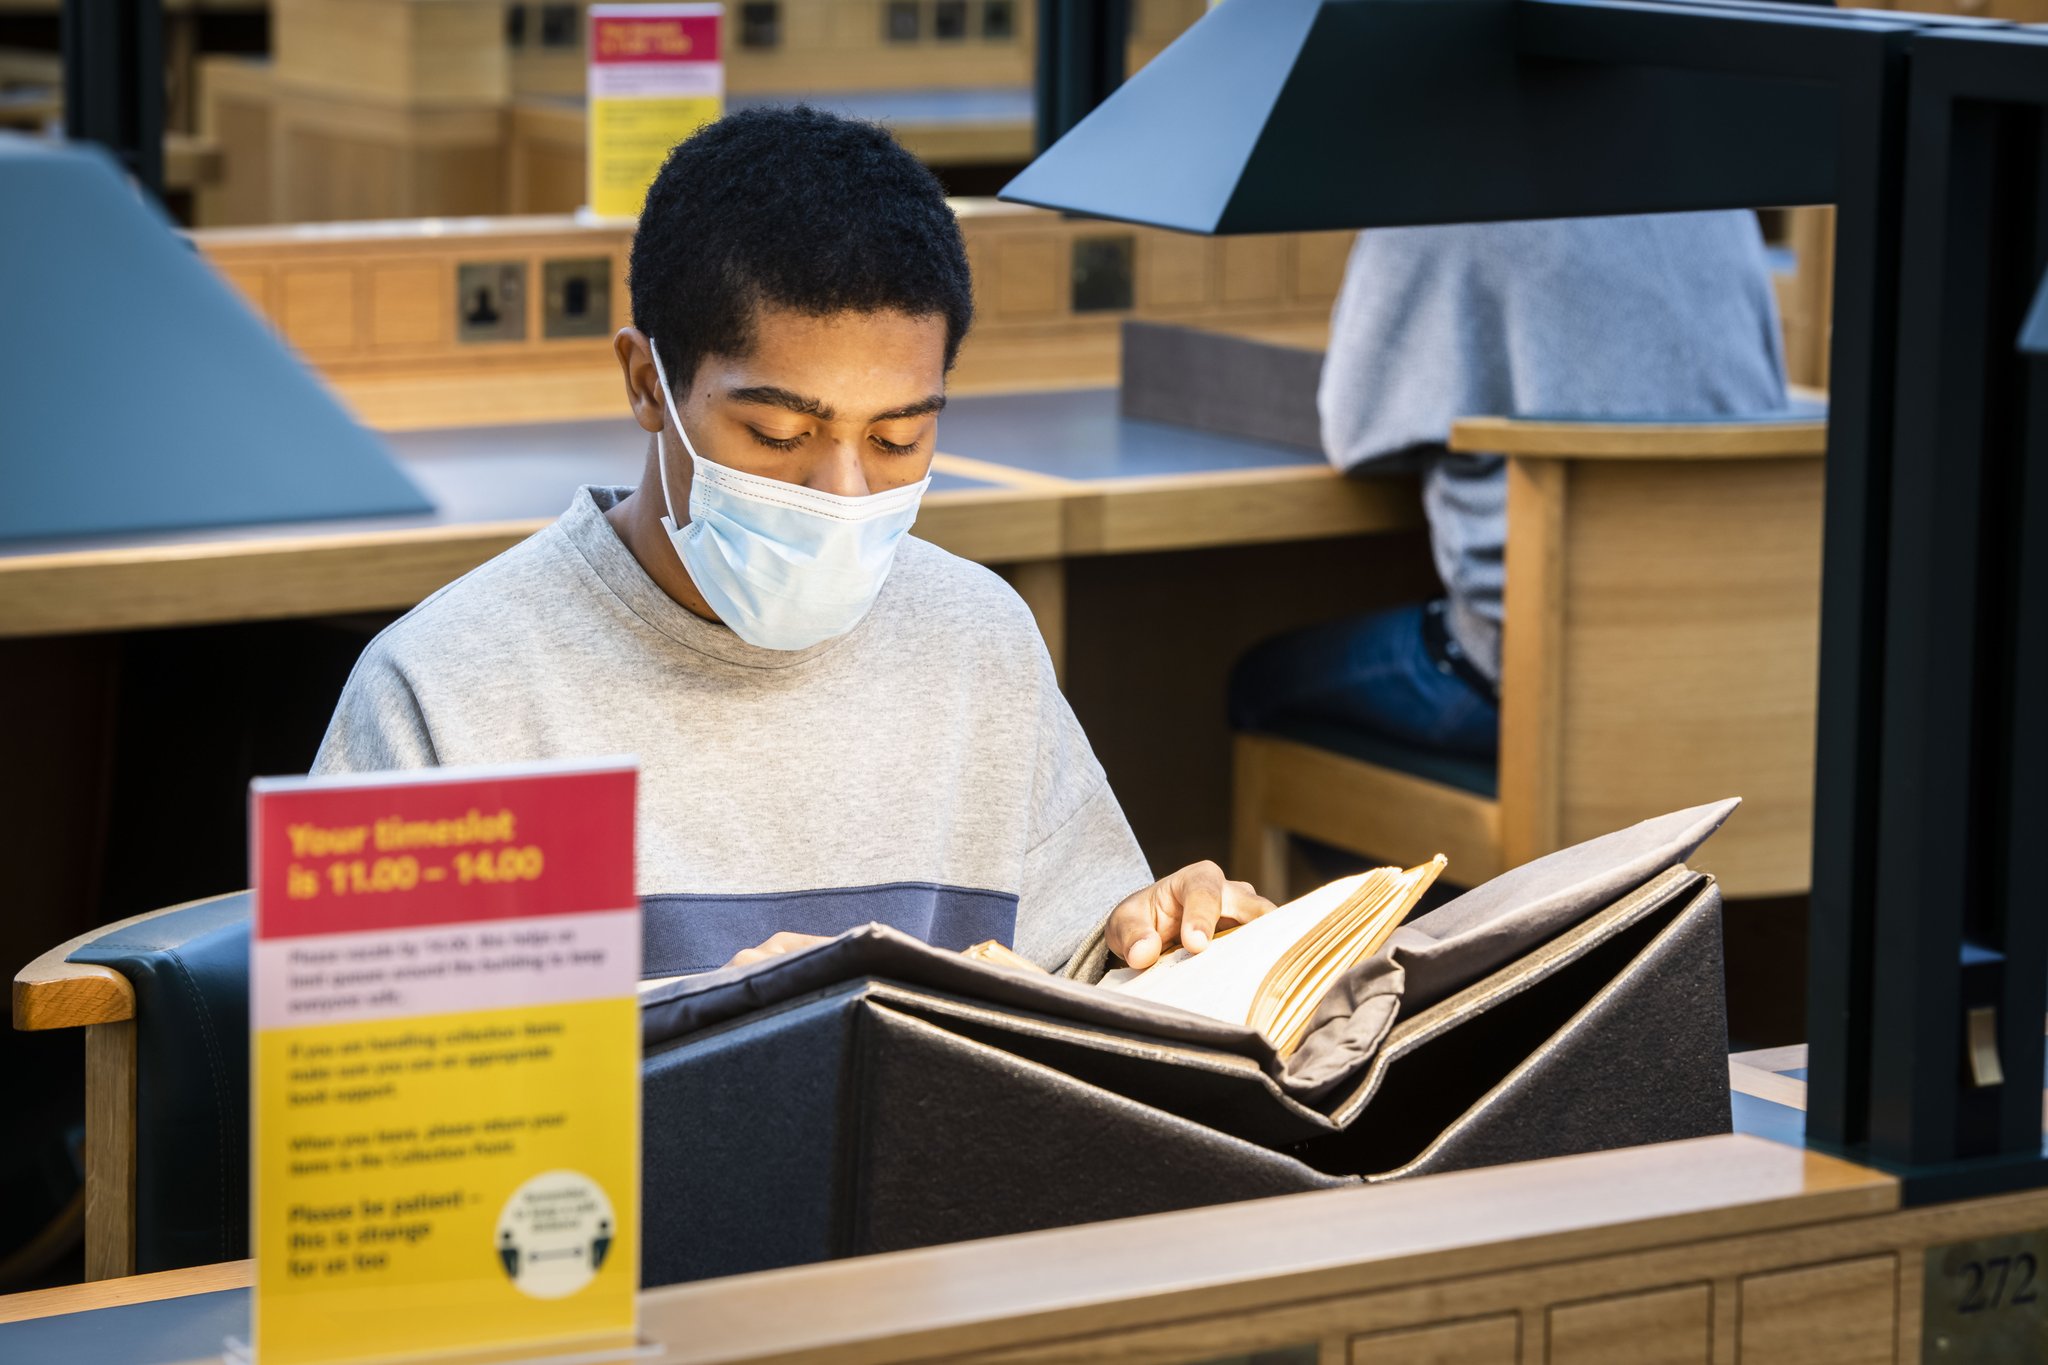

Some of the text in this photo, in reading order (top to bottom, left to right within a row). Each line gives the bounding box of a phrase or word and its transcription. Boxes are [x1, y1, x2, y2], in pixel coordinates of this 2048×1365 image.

[287, 809, 516, 858] Your timeslot
[287, 863, 319, 898] is
[326, 855, 420, 895] 11.00
[451, 845, 545, 886] 14.00
[1956, 1250, 2040, 1315] 272
